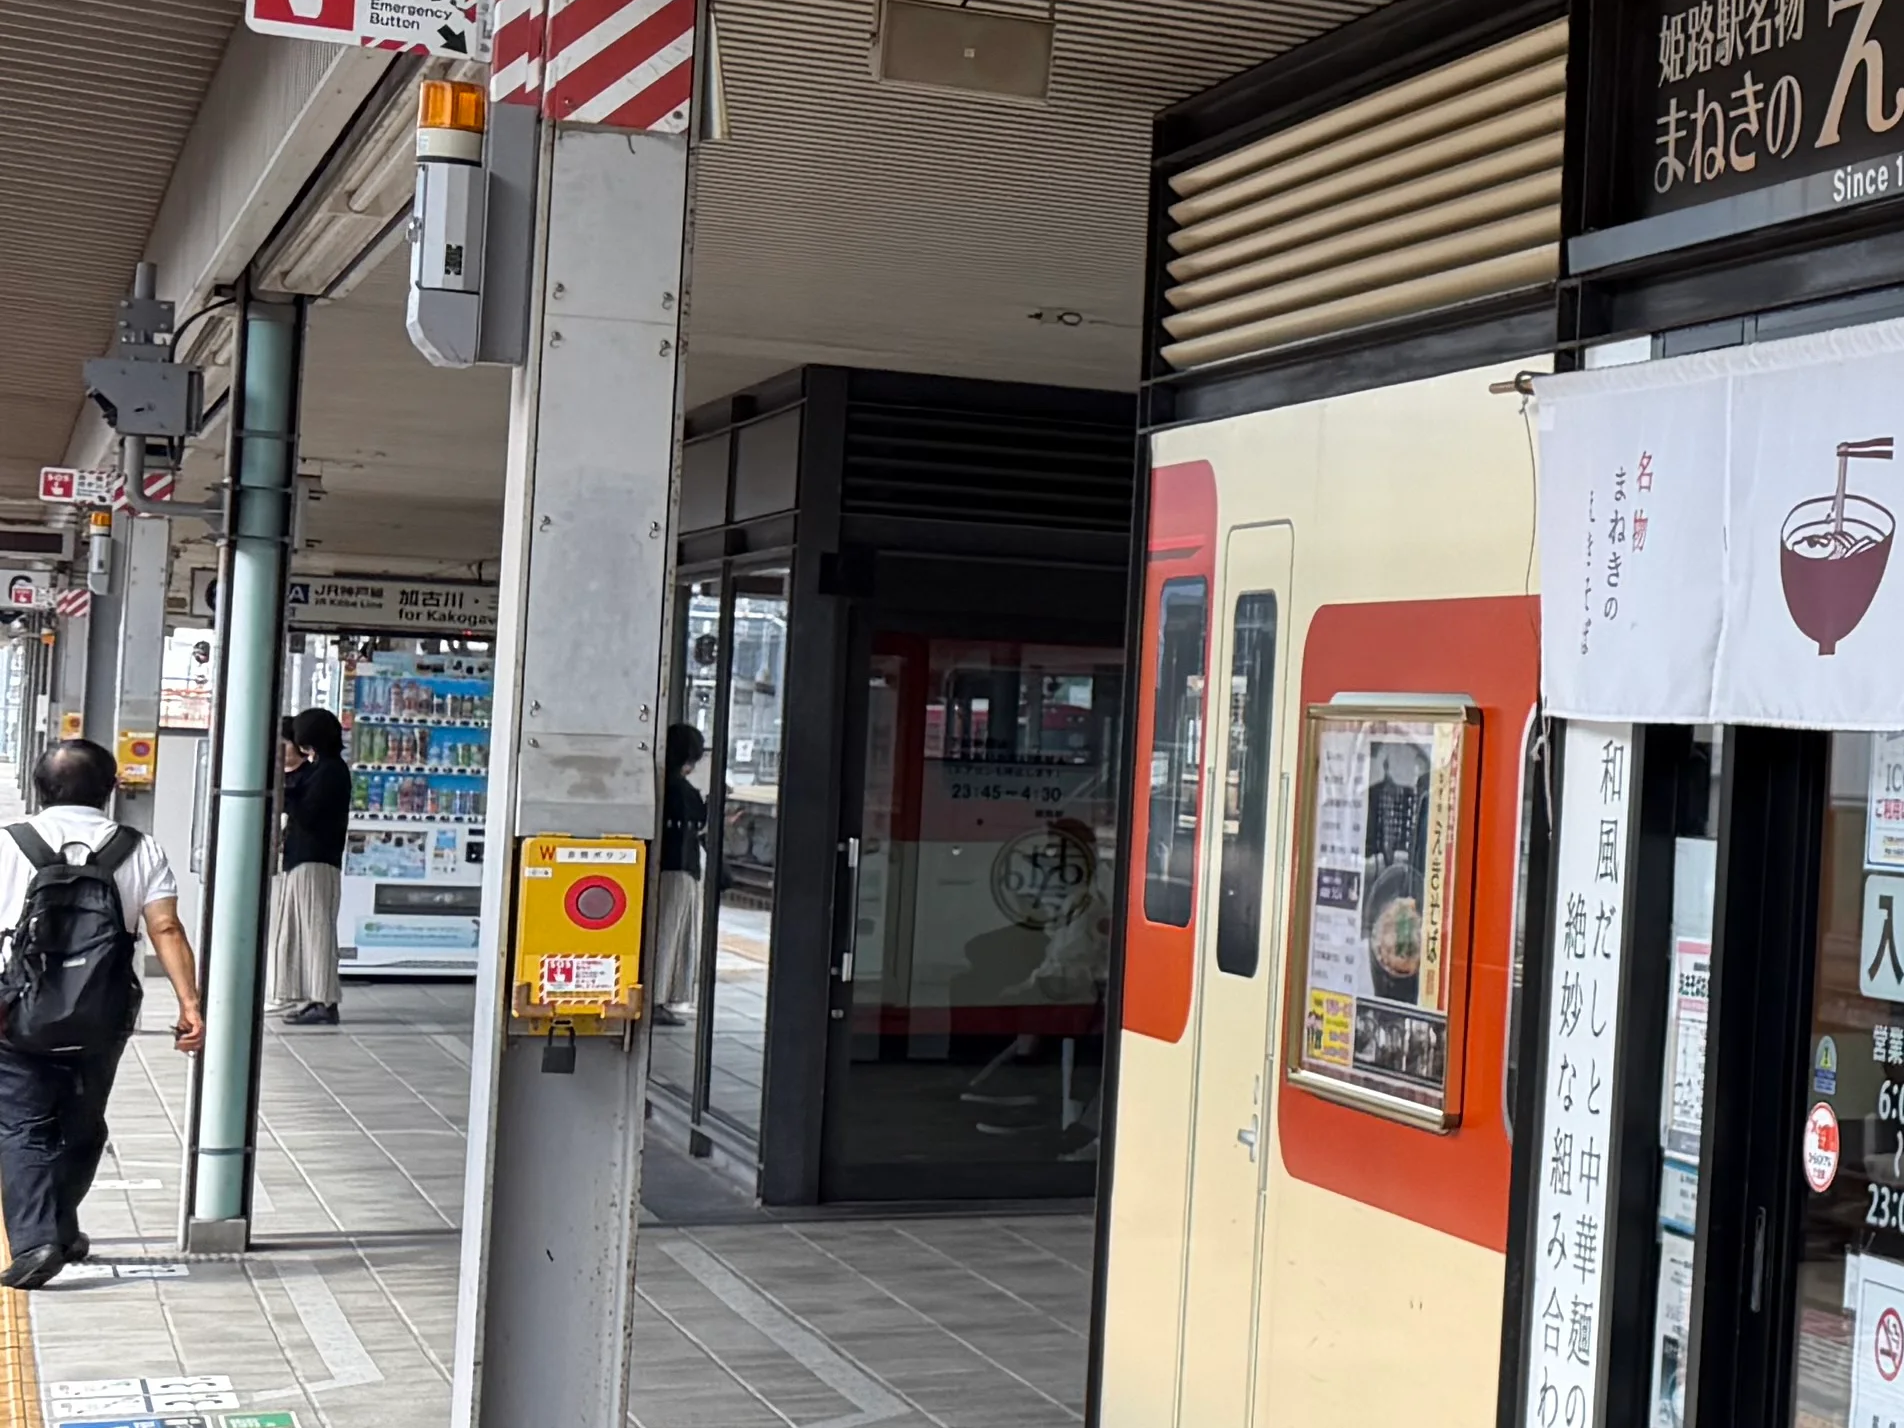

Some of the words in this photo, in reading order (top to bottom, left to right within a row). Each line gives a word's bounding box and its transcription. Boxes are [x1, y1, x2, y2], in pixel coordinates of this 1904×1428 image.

[370, 12, 420, 30] Button
[1653, 71, 1802, 194] まねきの
[1833, 163, 1889, 203] Since
[1631, 450, 1653, 554] 名物
[1603, 467, 1627, 623] まねきの
[399, 608, 420, 621] for
[540, 845, 556, 861] W
